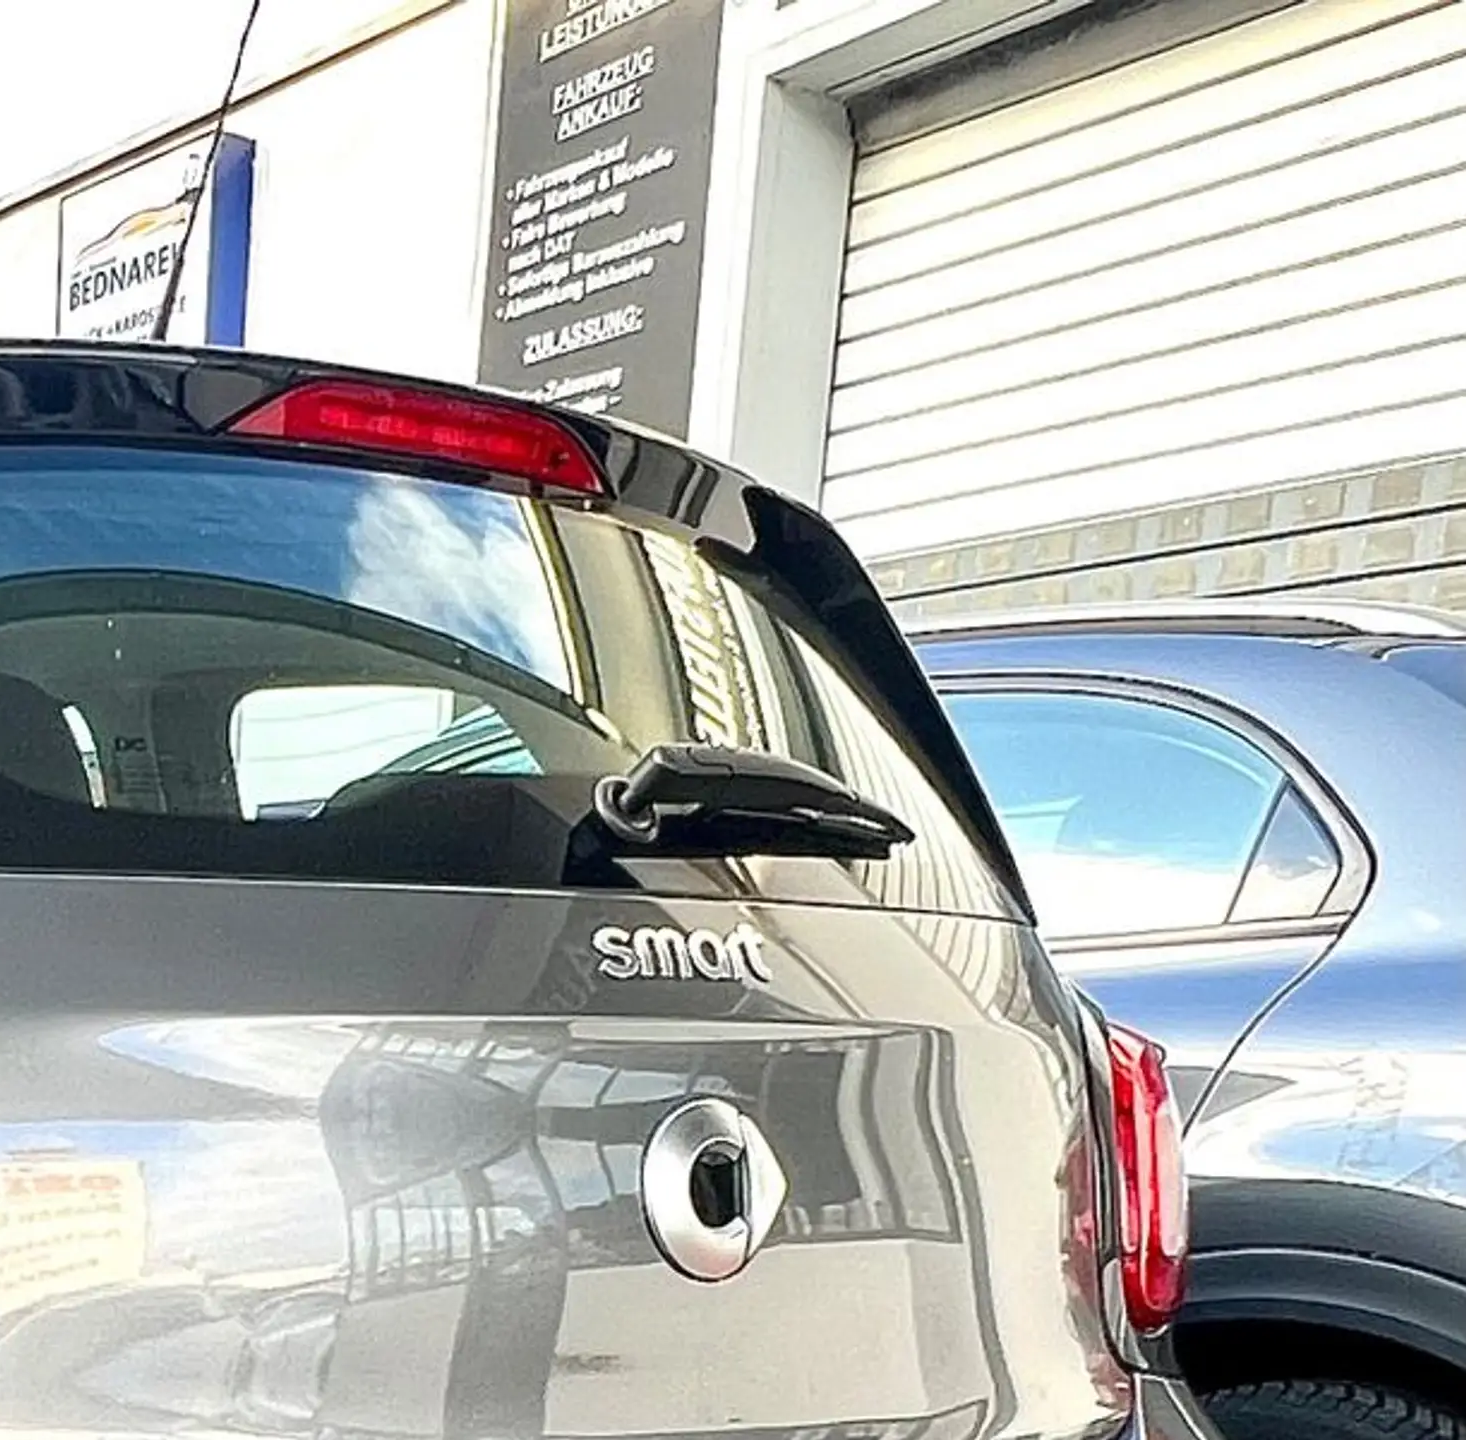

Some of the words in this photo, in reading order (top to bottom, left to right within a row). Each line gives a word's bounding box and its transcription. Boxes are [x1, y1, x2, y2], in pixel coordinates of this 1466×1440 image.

[539, 0, 675, 63] LEISTUNG
[551, 45, 655, 115] FAHRZEUG
[556, 84, 644, 143] ANKAUF:
[522, 303, 645, 366] ZULASSUNG:
[592, 922, 774, 989] smart
